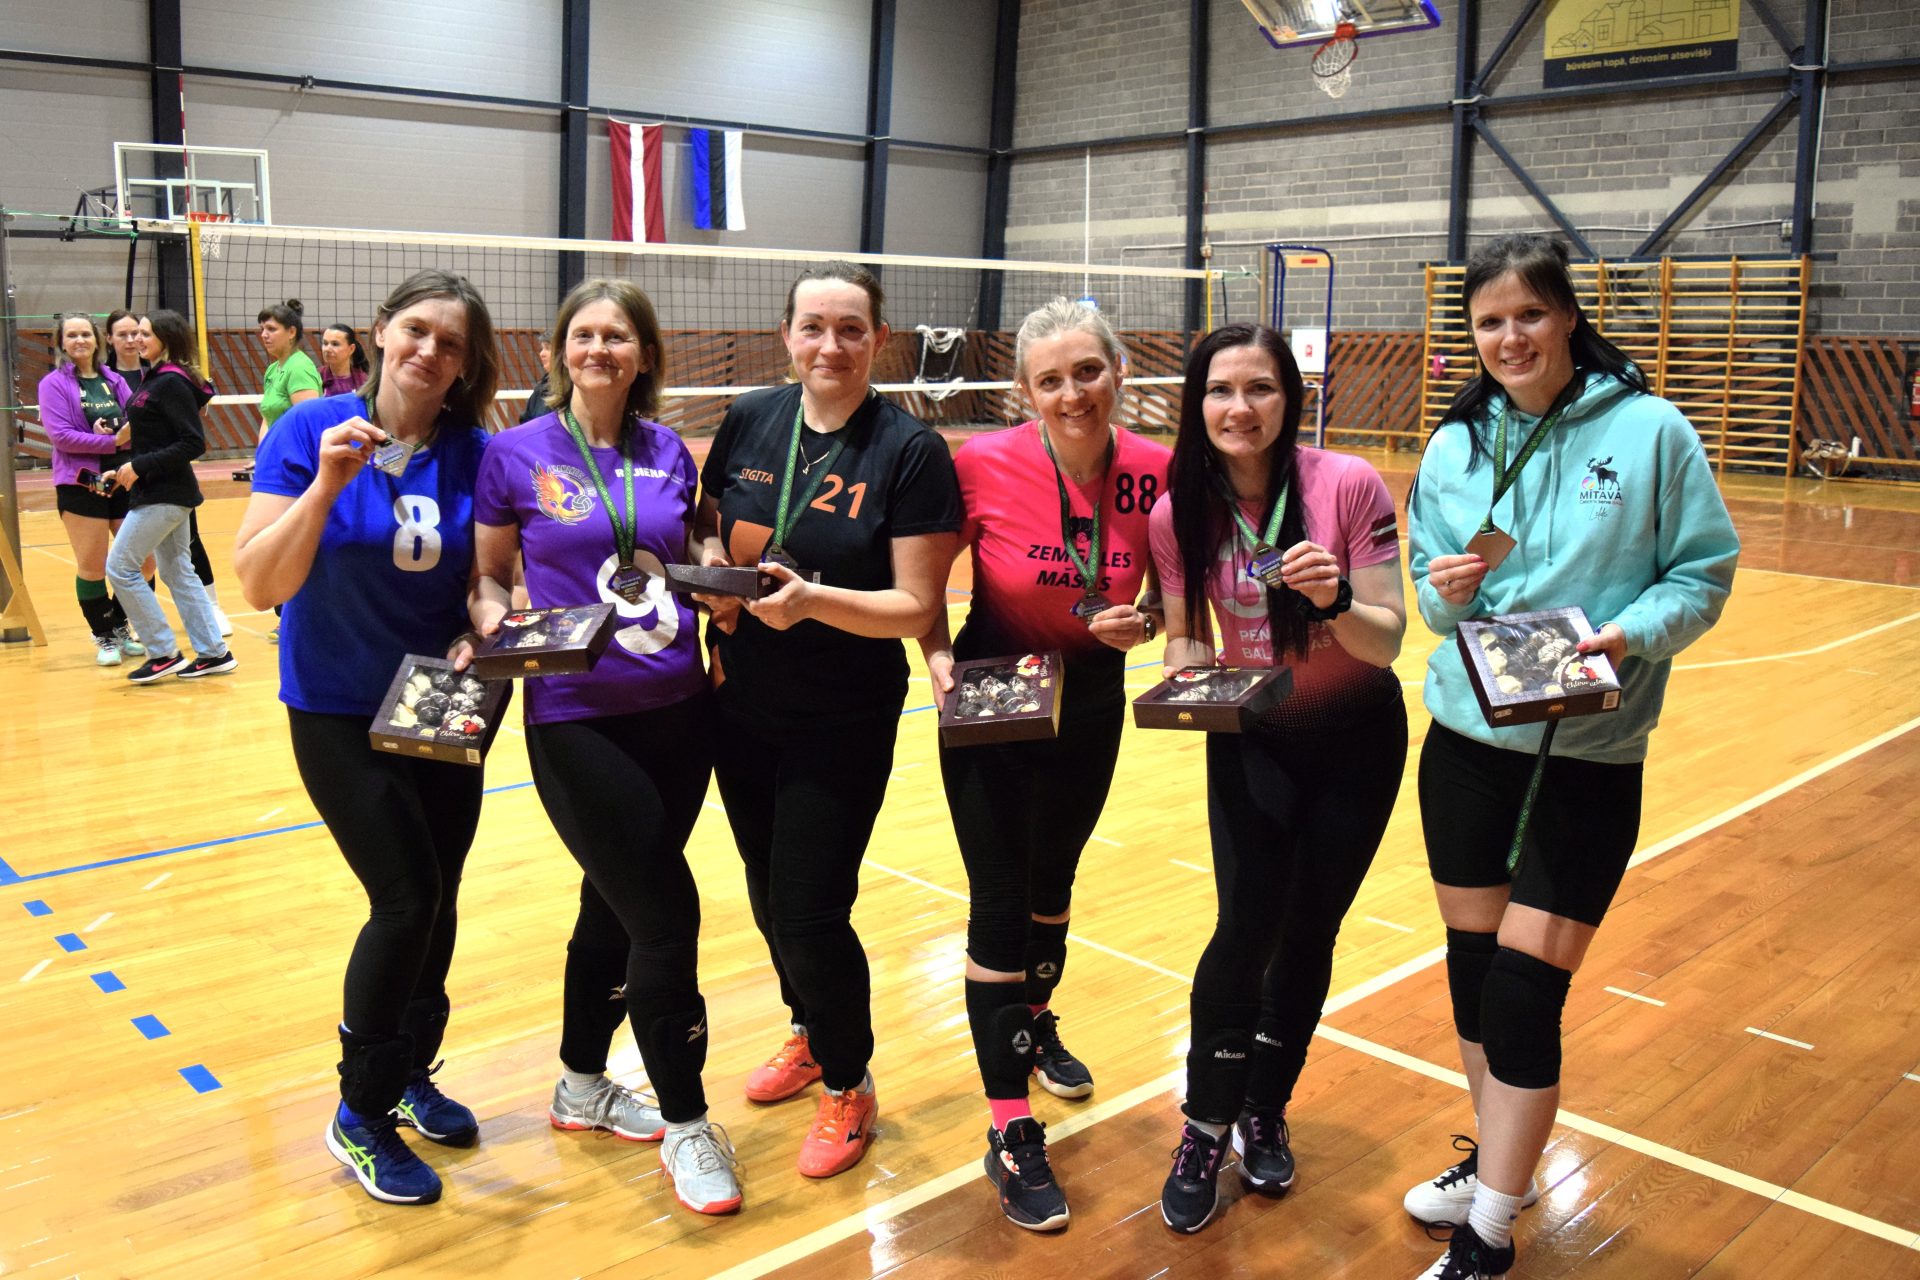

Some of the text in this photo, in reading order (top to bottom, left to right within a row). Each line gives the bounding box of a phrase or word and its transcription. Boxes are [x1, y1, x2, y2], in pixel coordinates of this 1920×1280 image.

[739, 467, 774, 485] SIGITA
[810, 473, 867, 519] 21
[1115, 472, 1158, 515] 88
[393, 494, 442, 572] 8
[1027, 545, 1132, 568] ZEMGLES
[1036, 567, 1112, 592] MĀSS
[597, 549, 679, 655] 9
